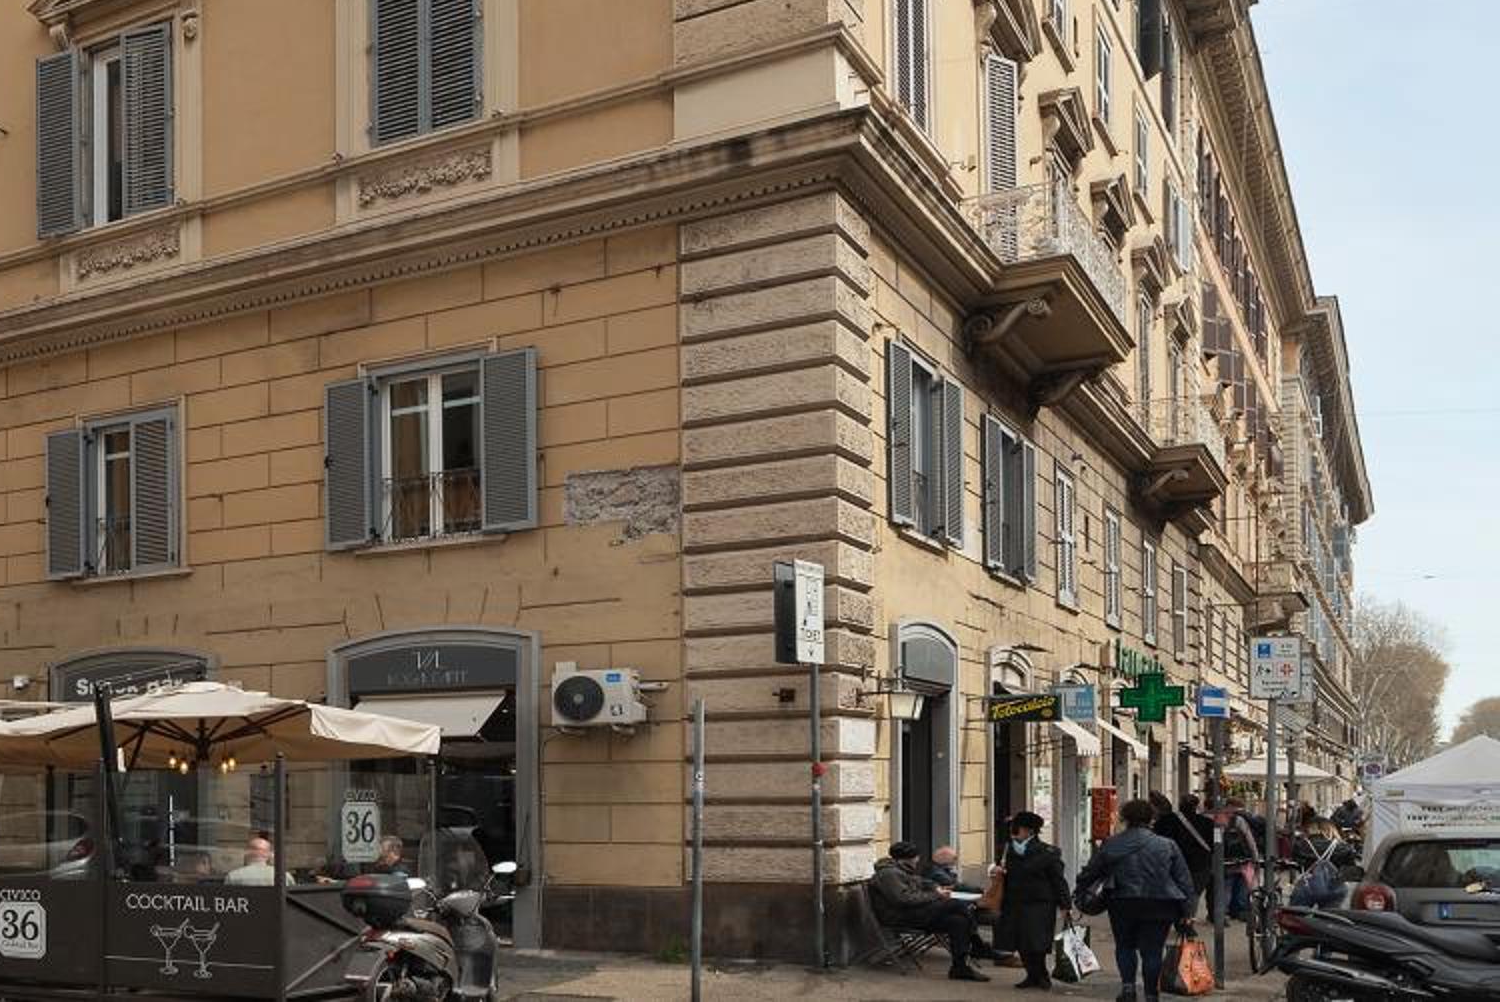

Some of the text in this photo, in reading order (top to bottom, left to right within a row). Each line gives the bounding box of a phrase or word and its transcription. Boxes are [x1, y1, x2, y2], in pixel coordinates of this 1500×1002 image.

[346, 810, 375, 843] 36
[0, 889, 41, 900] CIVICO
[125, 893, 249, 913] COCKTAIL BAR
[2, 909, 39, 940] 36
